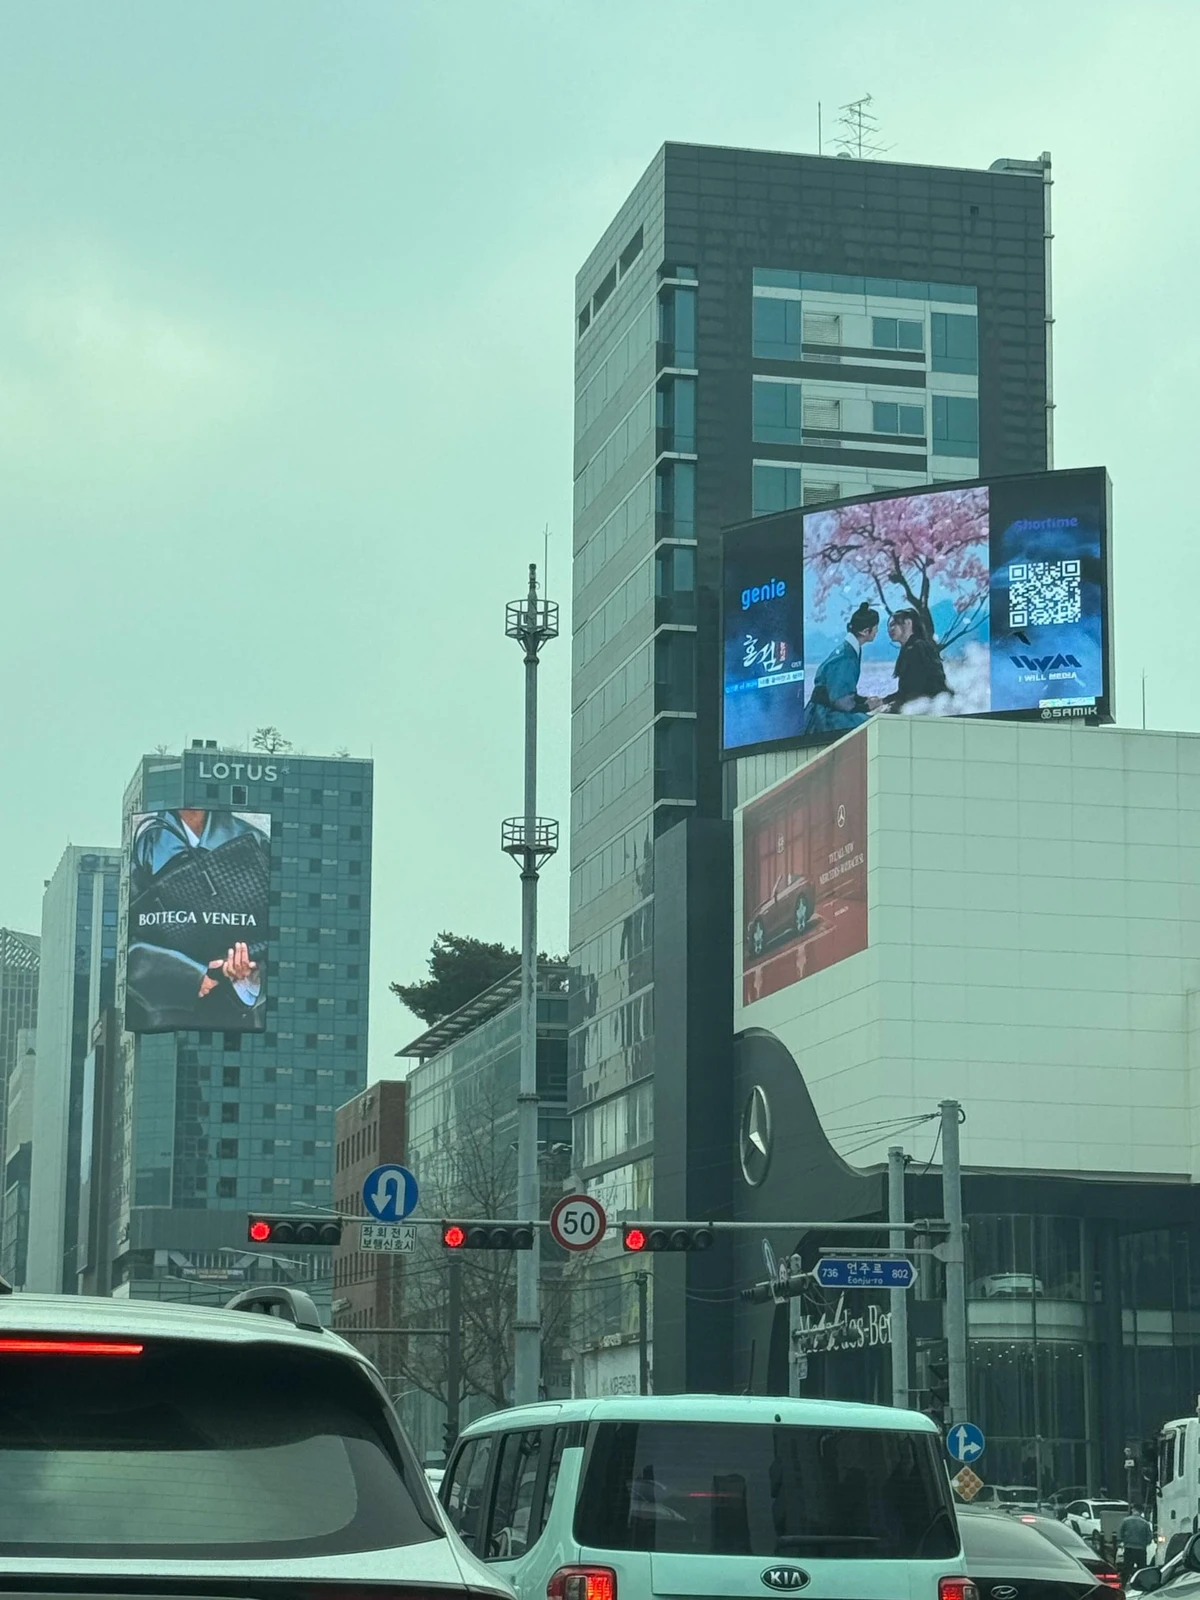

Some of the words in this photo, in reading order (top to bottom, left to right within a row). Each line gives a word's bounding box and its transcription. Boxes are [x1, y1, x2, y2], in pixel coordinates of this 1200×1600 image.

[741, 578, 786, 610] genie
[1024, 673, 1047, 682] WILL
[1052, 706, 1098, 718] SAMIK
[199, 761, 278, 782] LOTUS
[139, 911, 197, 926] BOTTEGA
[202, 911, 257, 926] VENETA
[563, 1211, 595, 1236] 50
[822, 1268, 839, 1278] 736
[891, 1269, 908, 1279] 802
[770, 1571, 803, 1585] KIA
